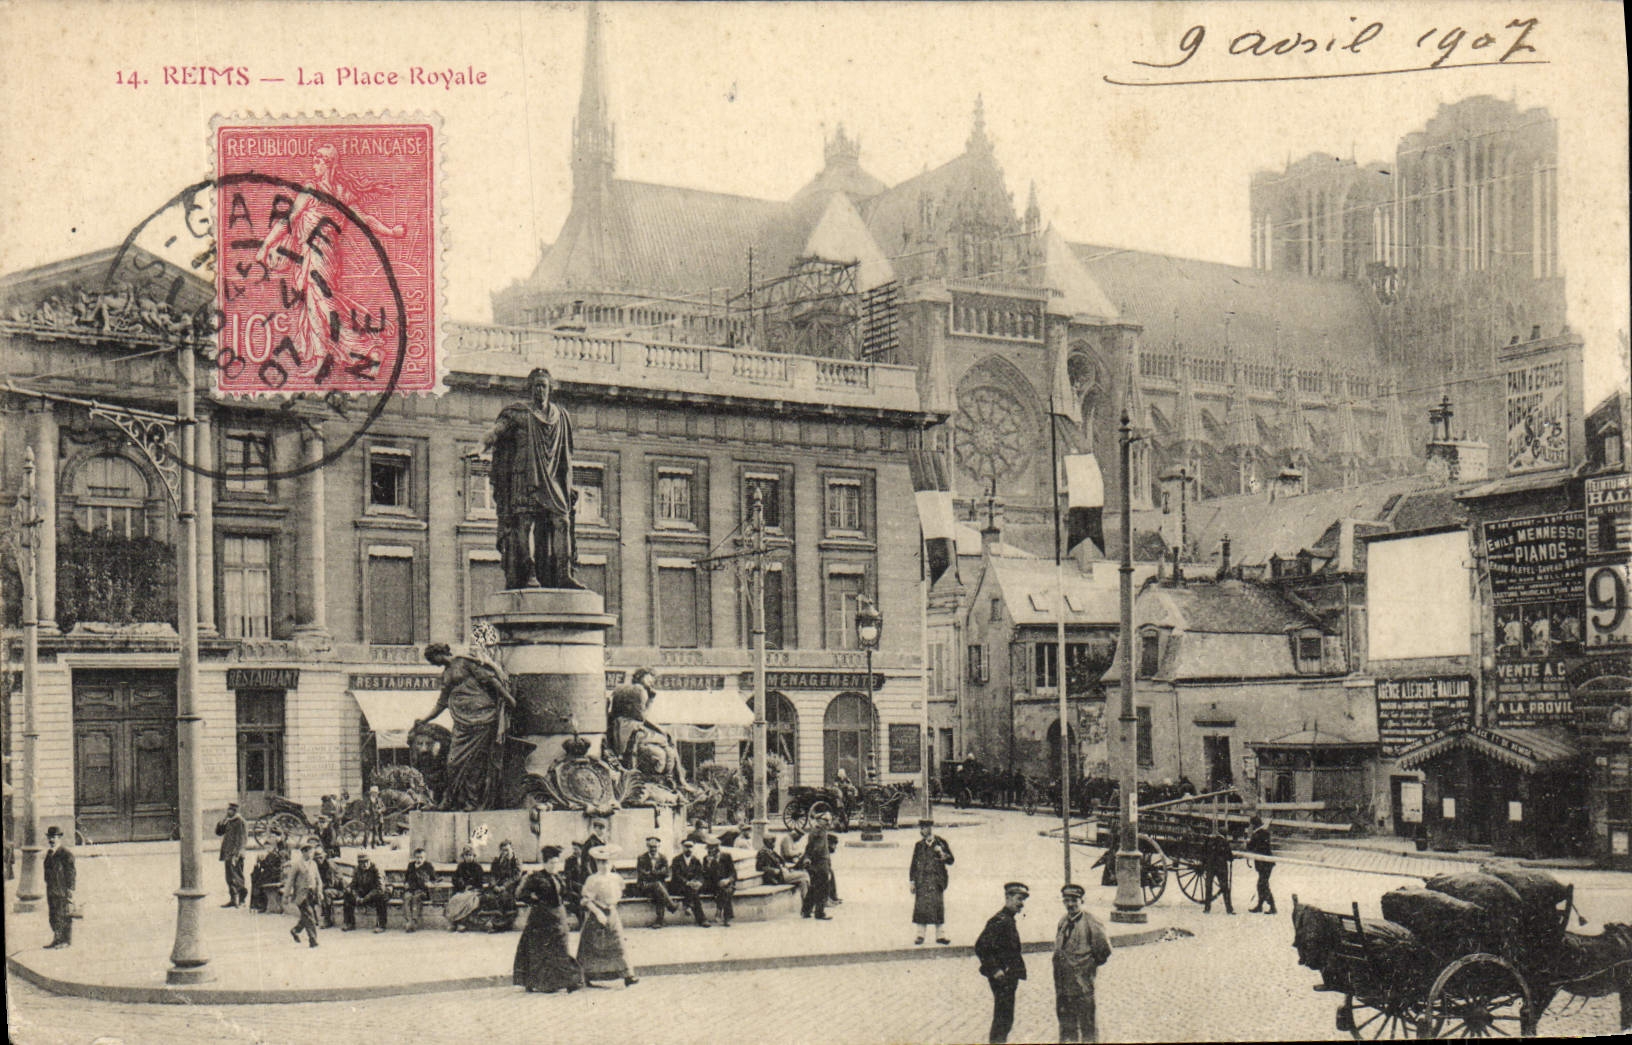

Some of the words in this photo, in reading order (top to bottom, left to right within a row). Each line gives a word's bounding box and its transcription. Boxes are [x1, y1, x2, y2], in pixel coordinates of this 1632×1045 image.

[1228, 16, 1385, 56] avril
[1416, 17, 1537, 69] 1907
[404, 287, 426, 377] POSTES
[1588, 489, 1631, 506] HAL
[1515, 541, 1568, 563] PIANOS
[1588, 567, 1626, 634] 9
[228, 669, 298, 689] RESTAURANT
[1497, 663, 1540, 678] VENTE
[1544, 662, 1553, 676] A
[356, 676, 438, 690] RESTAURANT
[655, 676, 719, 690] ESTAURANT
[1497, 702, 1506, 714] A
[1509, 702, 1525, 714] LA
